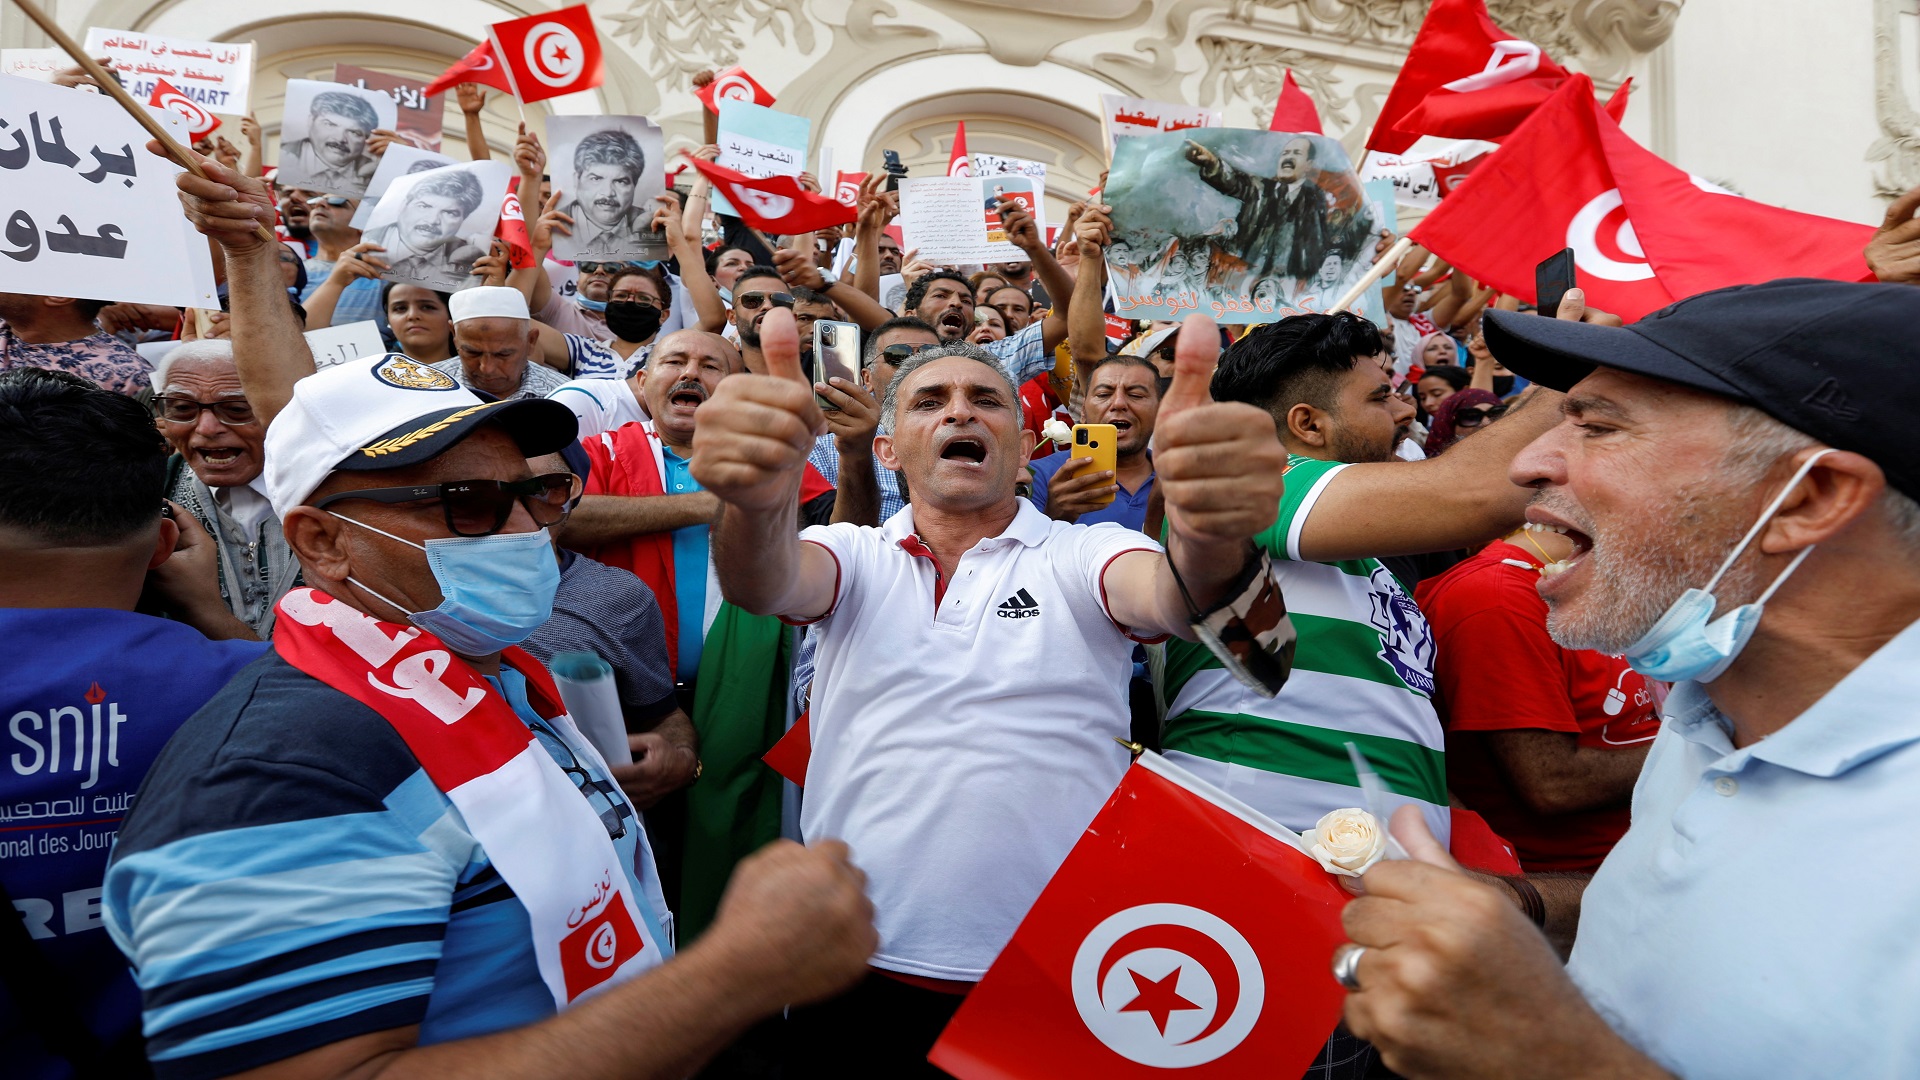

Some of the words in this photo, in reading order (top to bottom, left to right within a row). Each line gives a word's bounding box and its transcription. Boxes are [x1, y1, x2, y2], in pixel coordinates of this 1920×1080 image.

[103, 36, 147, 51] العالم
[151, 41, 167, 57] في
[171, 46, 212, 60] شعب
[1114, 105, 1161, 130] سعيد
[0, 111, 138, 189] برلمان
[729, 142, 754, 157] يريد
[0, 209, 128, 262] عدو
[1117, 290, 1199, 315] لتونس
[9, 702, 127, 789] snjt
[0, 833, 35, 859] onal
[38, 832, 69, 855] des
[73, 829, 119, 852] Journ
[567, 868, 611, 929] تونس
[12, 886, 104, 940] RE
